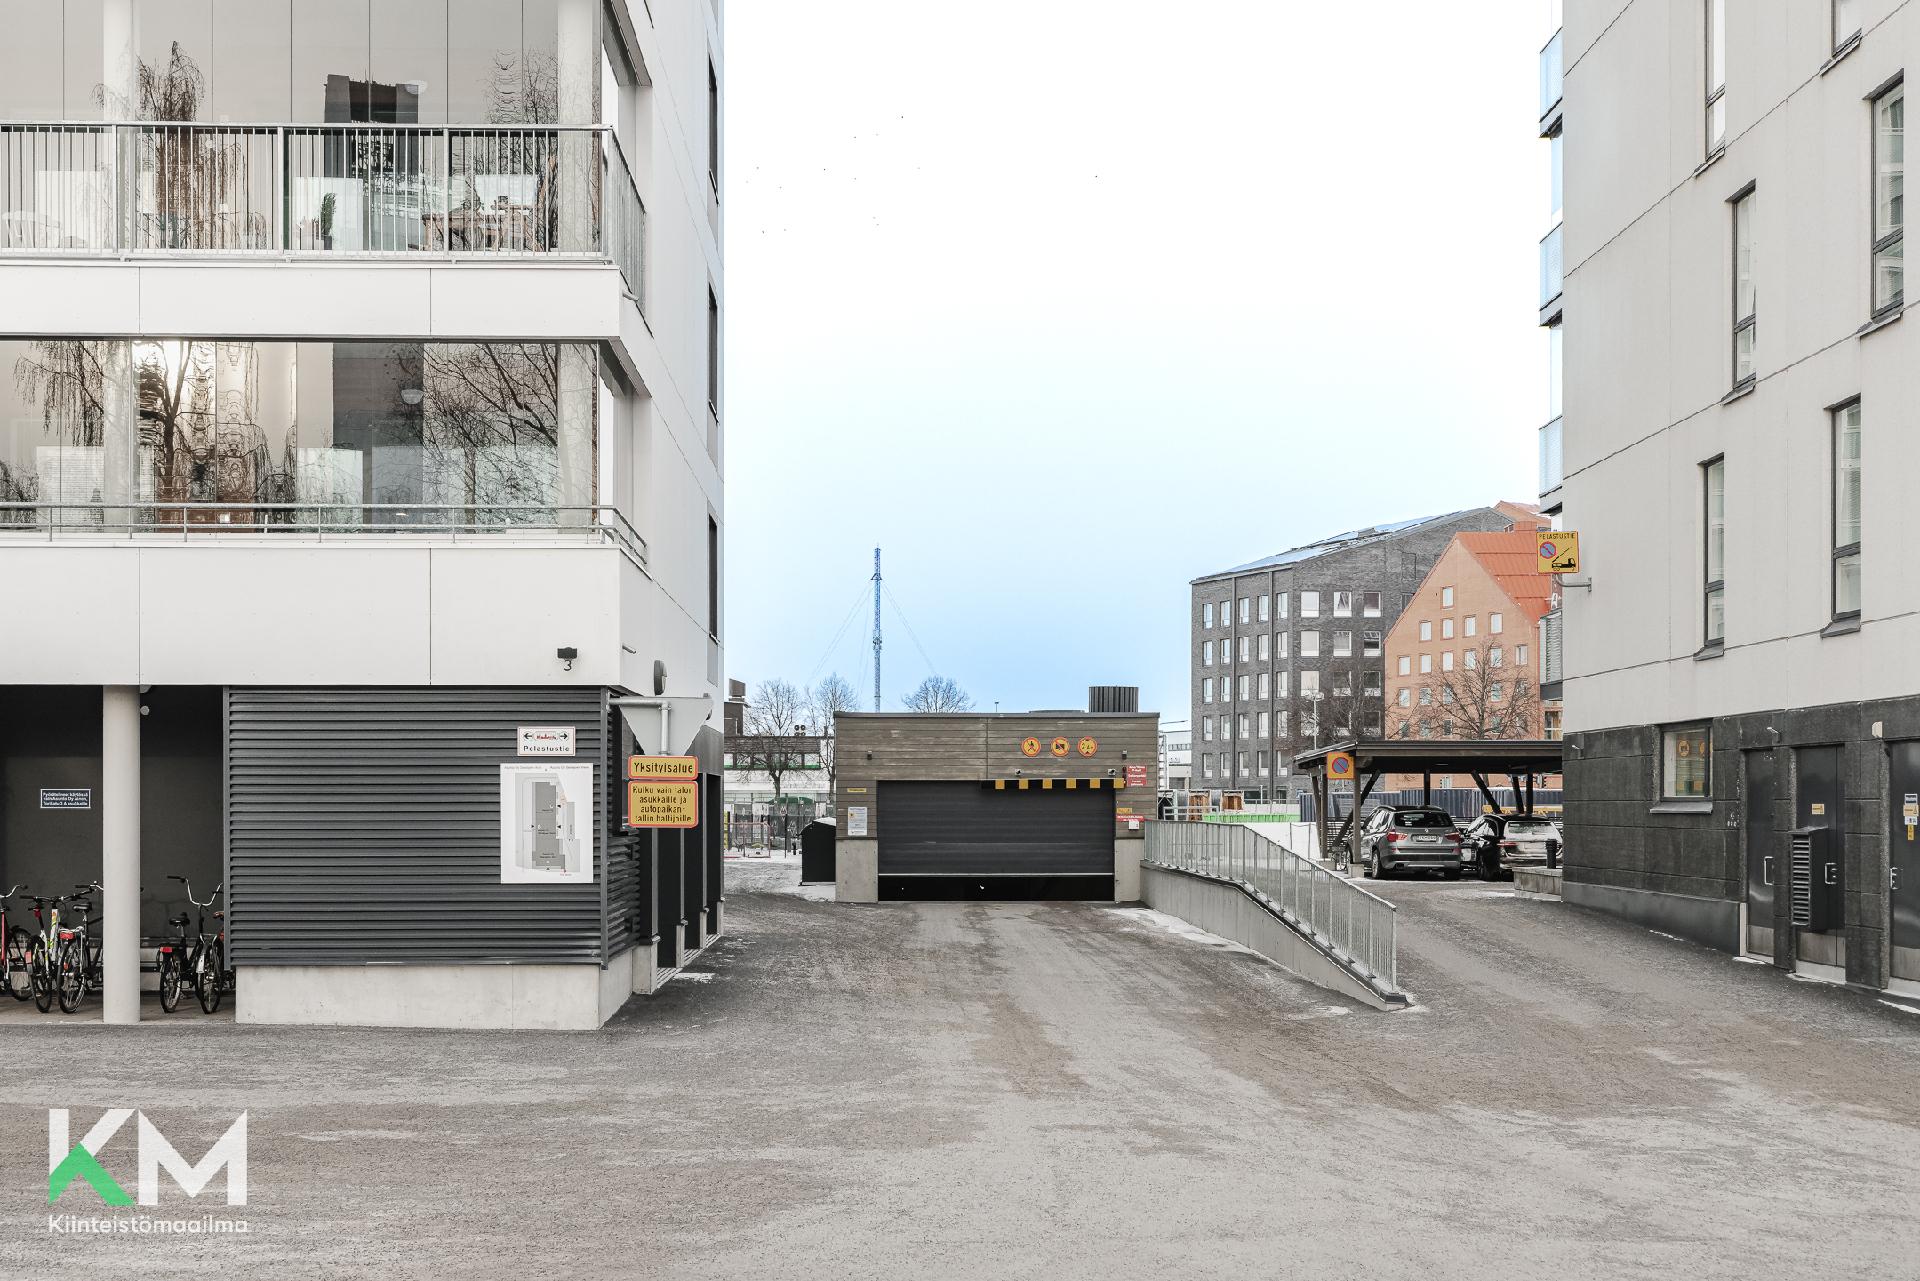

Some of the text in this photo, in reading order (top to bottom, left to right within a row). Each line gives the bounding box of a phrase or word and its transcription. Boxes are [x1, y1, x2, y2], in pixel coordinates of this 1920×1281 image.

[563, 659, 572, 672] 3
[634, 762, 693, 774] Yksityisalue
[657, 786, 672, 794] vain
[639, 796, 687, 805] asukkaille ja
